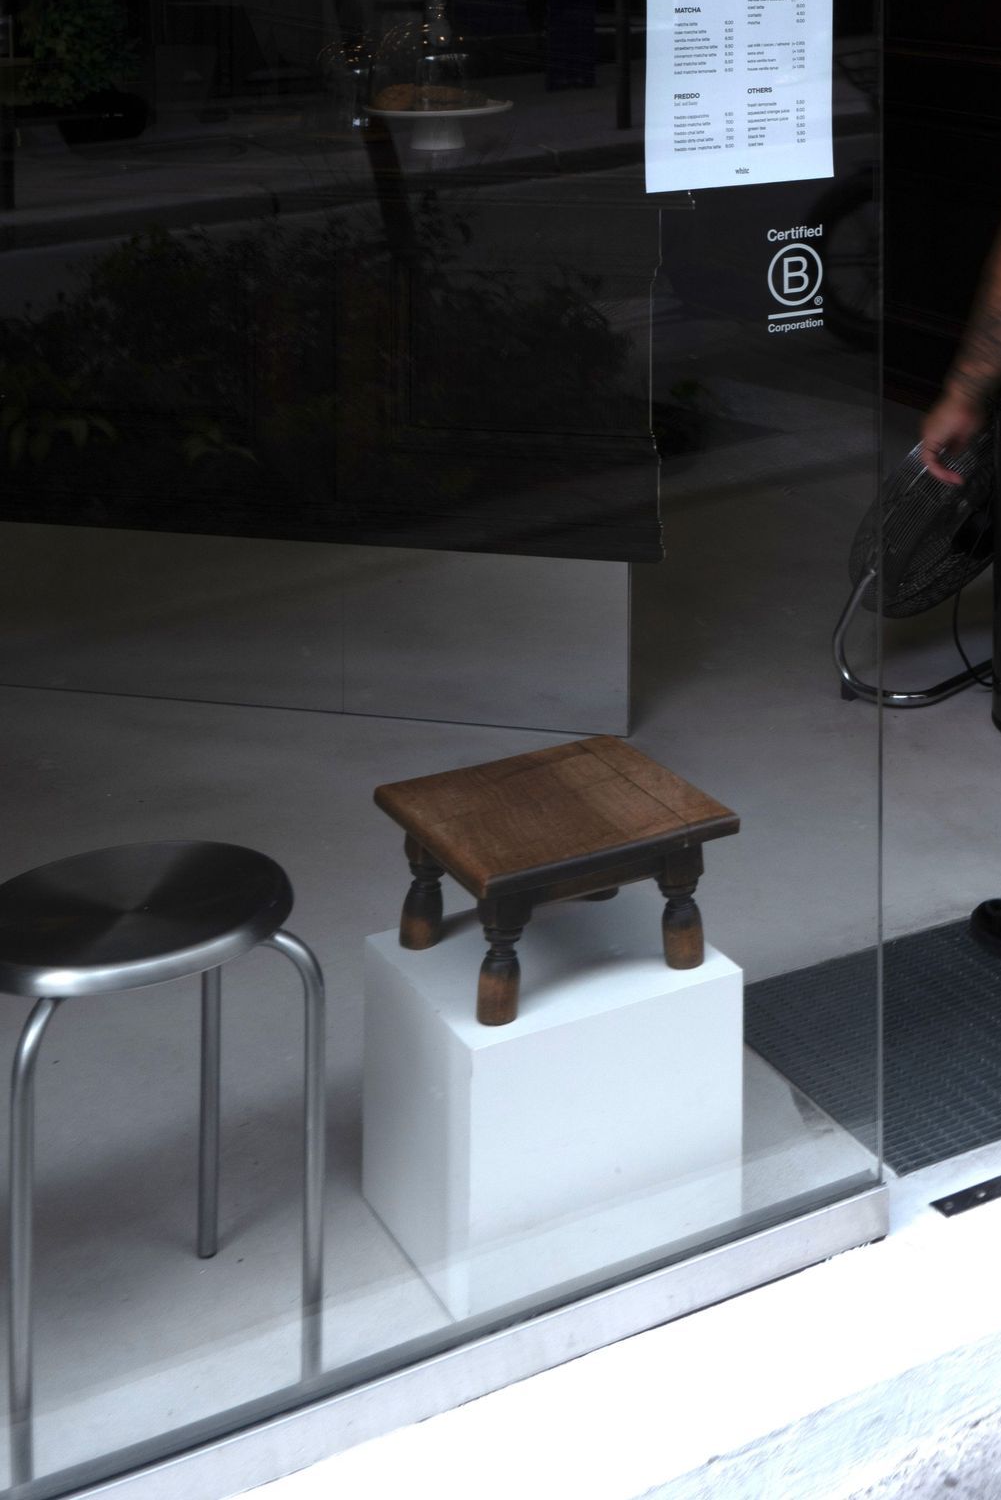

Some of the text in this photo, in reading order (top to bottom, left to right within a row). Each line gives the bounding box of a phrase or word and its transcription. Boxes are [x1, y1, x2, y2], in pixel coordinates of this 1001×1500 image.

[674, 92, 700, 100] FREDDO
[767, 223, 823, 242] Certified
[783, 256, 809, 294] B
[768, 318, 824, 333] Corporation
